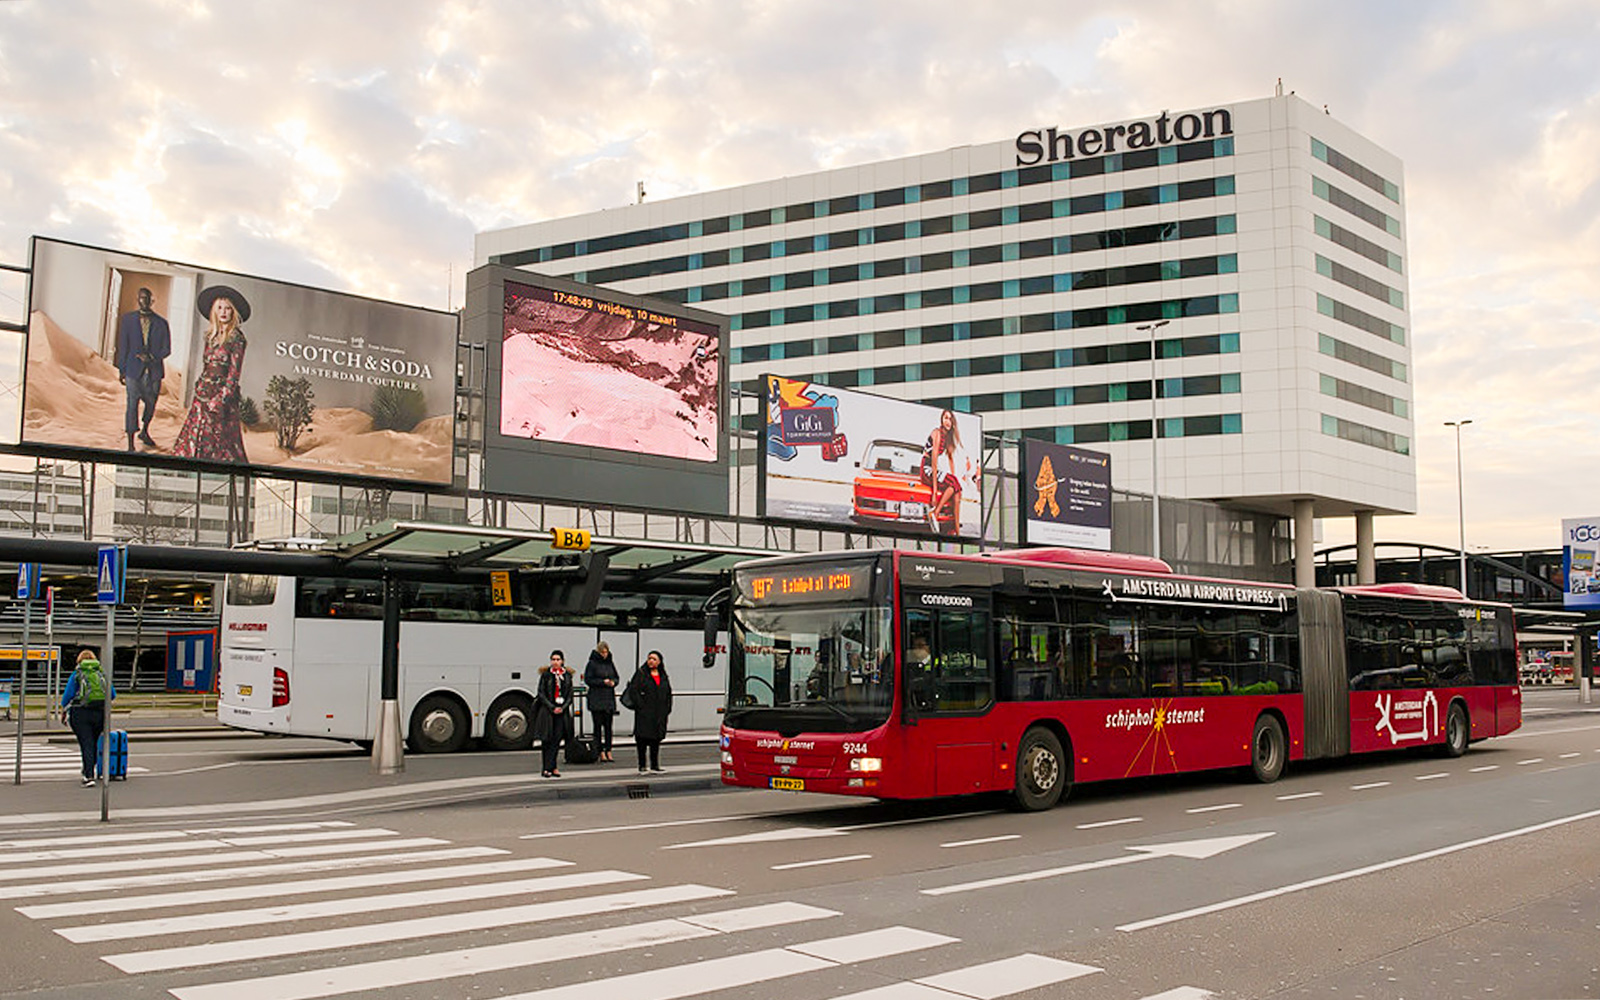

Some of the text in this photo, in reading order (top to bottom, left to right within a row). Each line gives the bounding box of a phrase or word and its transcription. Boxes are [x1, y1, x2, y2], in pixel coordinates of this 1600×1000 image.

[1016, 108, 1234, 167] Sheraton
[637, 309, 648, 319] 10
[649, 313, 677, 326] maart
[275, 341, 432, 379] SCOTCH & SODA
[293, 365, 418, 391] AMSTERDAM COUTURE
[564, 532, 583, 547] B4
[915, 565, 936, 573] MAN
[494, 588, 506, 603] B4
[1122, 578, 1274, 604] AMSTERDAM AIRPORT EXPRESS
[1394, 701, 1422, 711] AMSTERDAM
[1105, 707, 1205, 731] schiphol sternet
[756, 739, 783, 749] schiphol
[842, 742, 868, 754] 9244
